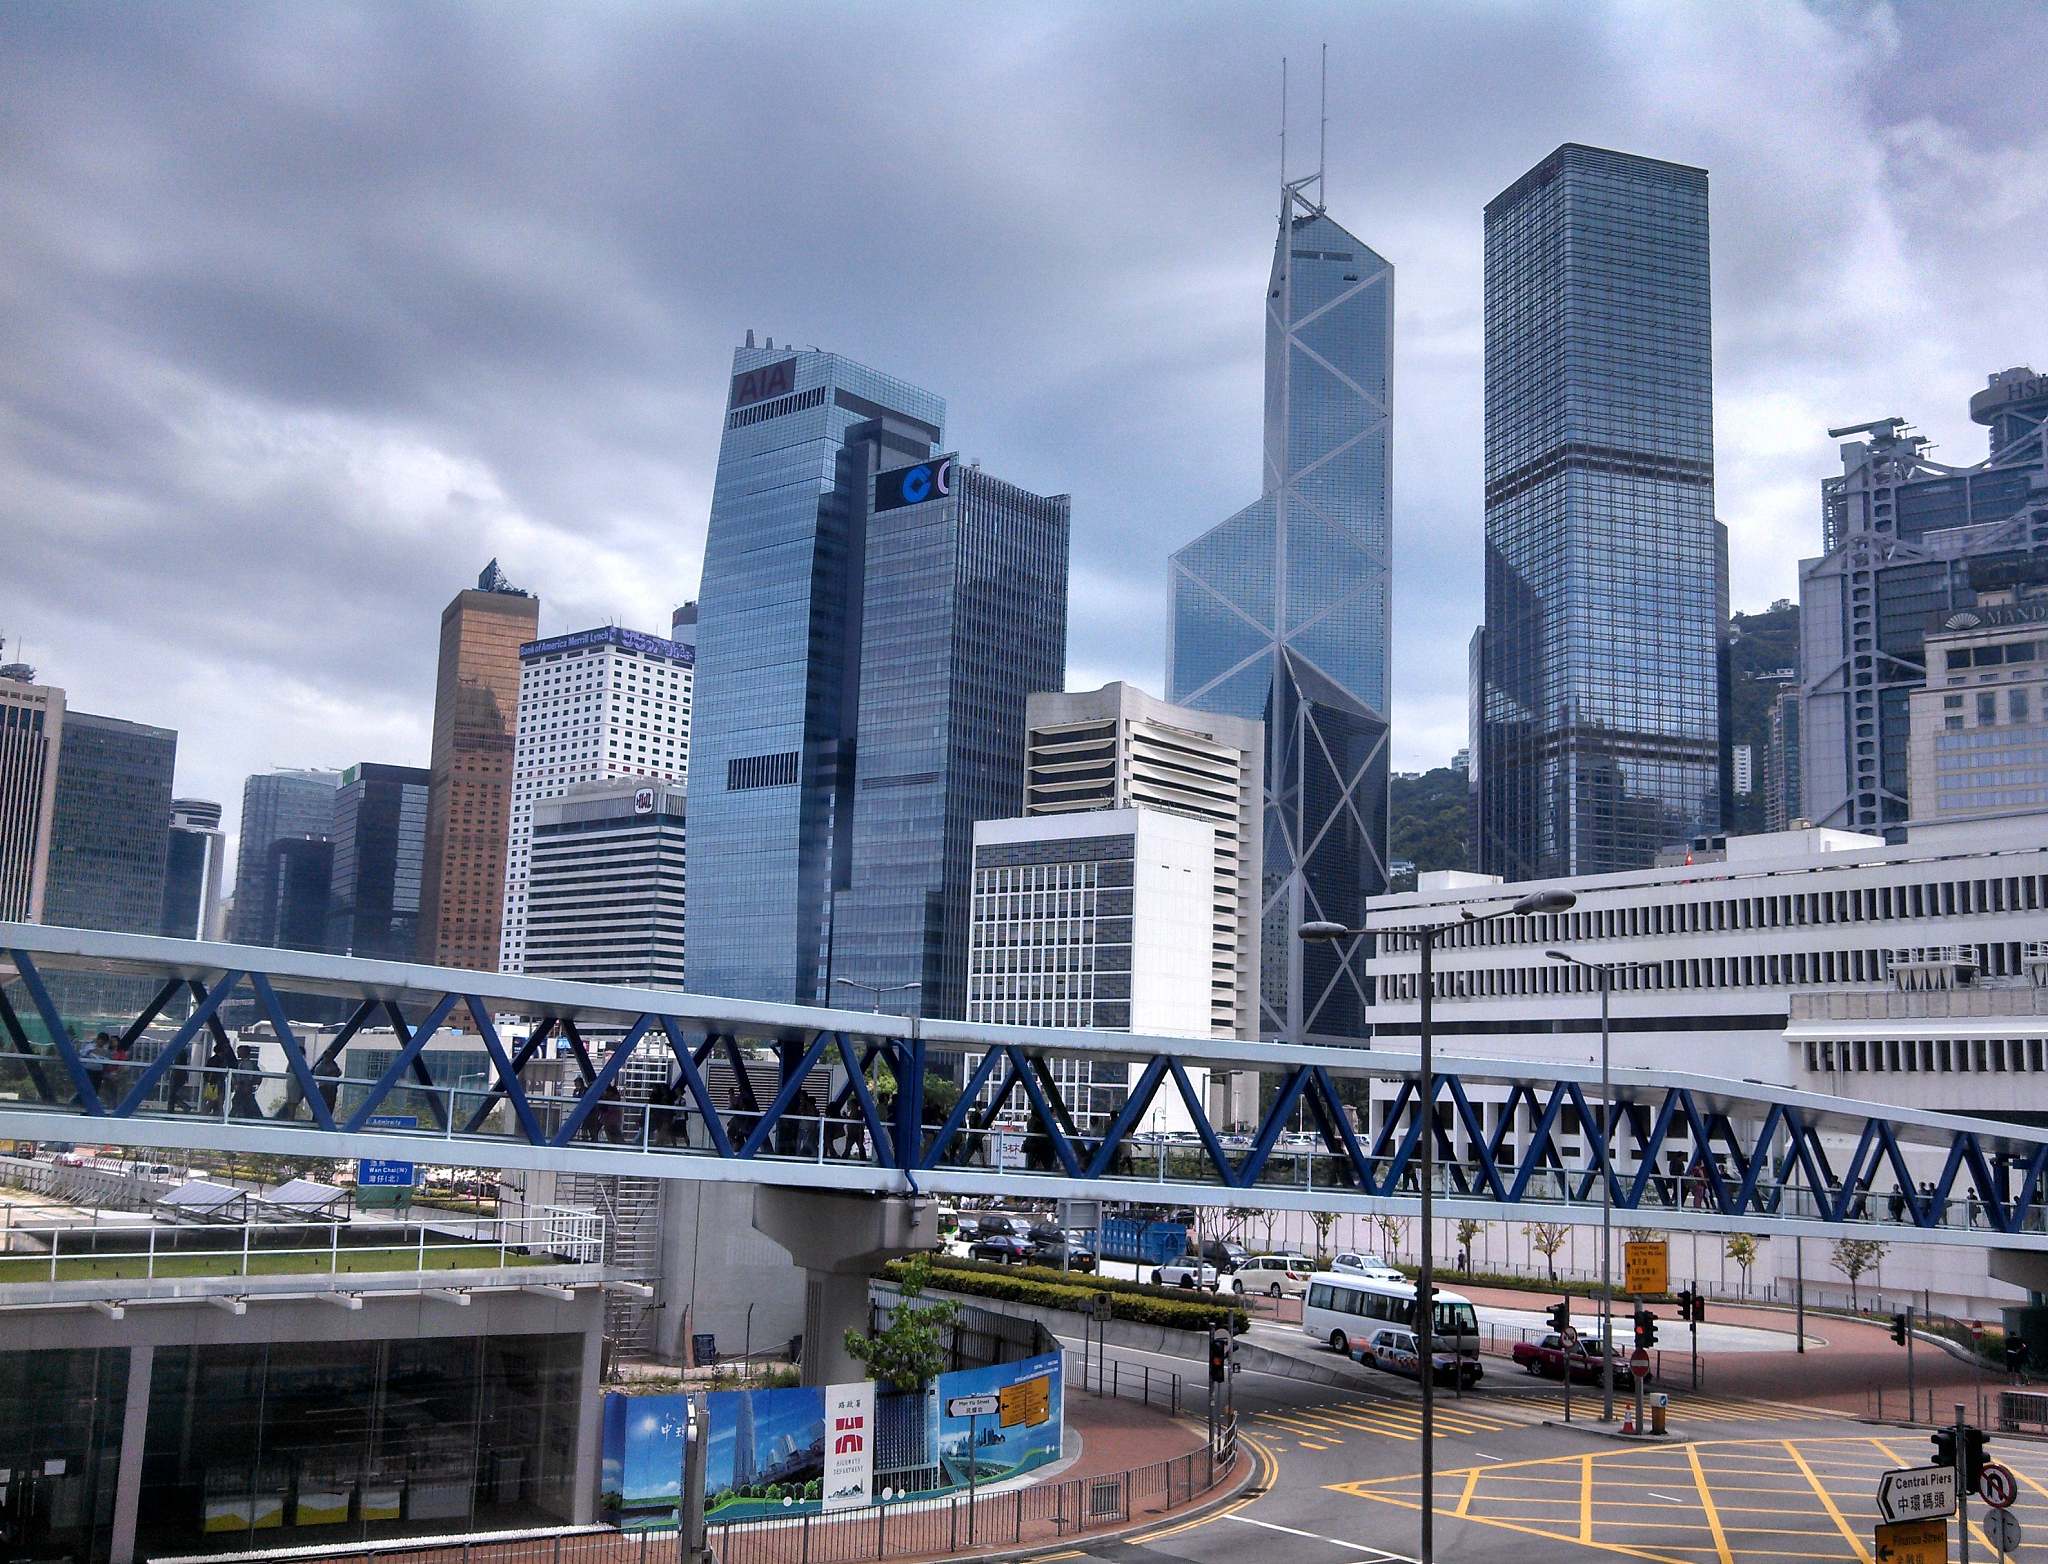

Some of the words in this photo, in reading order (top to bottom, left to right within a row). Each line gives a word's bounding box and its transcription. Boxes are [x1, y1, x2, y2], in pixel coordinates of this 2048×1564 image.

[738, 366, 788, 404] AIA
[520, 645, 535, 656] Bank
[541, 638, 568, 652] America
[568, 634, 589, 647] Merrill
[590, 630, 610, 645] Lynch
[833, 1466, 864, 1475] DEPARTMENT
[1895, 1475, 1929, 1490] Central
[1930, 1473, 1952, 1485] Piers
[1898, 1491, 1945, 1513] 中環碼頭
[1893, 1535, 1922, 1546] Finance
[1922, 1531, 1944, 1543] Street
